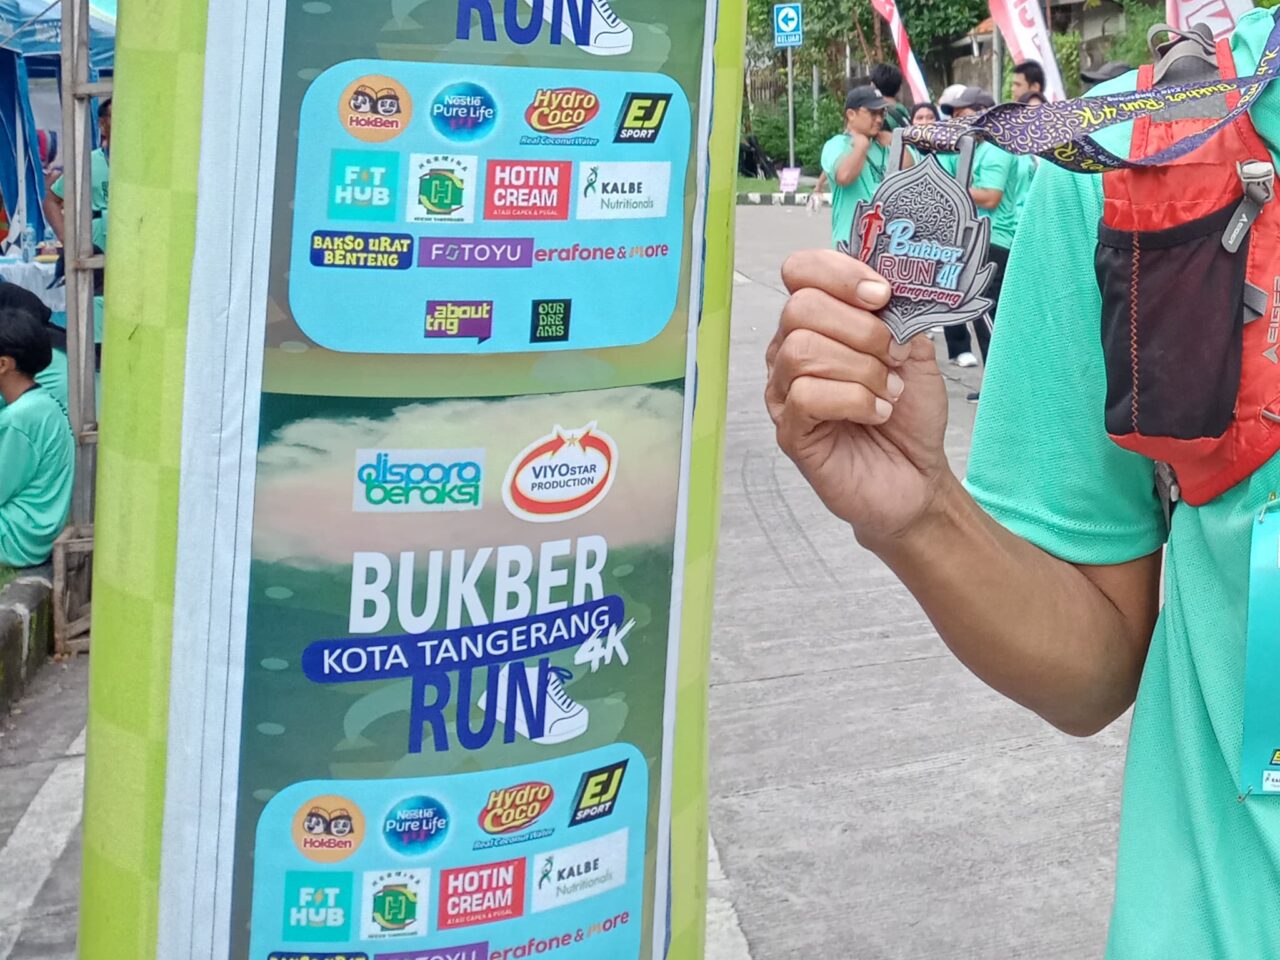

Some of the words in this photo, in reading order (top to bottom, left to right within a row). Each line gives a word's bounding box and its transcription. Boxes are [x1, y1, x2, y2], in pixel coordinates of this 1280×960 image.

[533, 89, 596, 111] Hydro
[349, 116, 398, 129] HokBen
[433, 104, 467, 118] Pure
[470, 106, 494, 123] Life
[623, 99, 667, 128] EJ
[620, 129, 655, 138] SPORT
[494, 166, 559, 186] HOTIN
[335, 185, 390, 206] HUB
[493, 189, 557, 207] CREAM
[601, 182, 643, 194] KALBE
[601, 197, 654, 211] Nutritionals
[324, 250, 399, 267] BENTENG
[534, 244, 614, 262] erafone
[617, 246, 626, 259] &
[877, 253, 937, 285] RUN
[434, 302, 491, 318] about
[538, 303, 565, 314] OUR
[425, 315, 459, 335] tng
[358, 453, 480, 486] dispora
[365, 471, 480, 506] beraksi
[530, 475, 595, 492] PRODUCTION
[348, 535, 608, 634] BUKBER
[322, 645, 408, 675] KOTA
[418, 606, 610, 667] TANGERANG
[574, 616, 636, 673] 4K
[408, 657, 550, 754] RUN
[487, 783, 551, 809] Hydro
[579, 767, 623, 809] EJ
[575, 802, 611, 820] SPORT
[386, 819, 420, 833] Pure
[422, 817, 447, 834] Life
[303, 838, 352, 849] HokBen
[448, 865, 514, 895] HOTIN
[557, 858, 600, 882] KALBE
[447, 889, 512, 915] CREAM
[290, 908, 345, 927] HUB
[490, 935, 571, 960] erafone
[574, 929, 584, 943] &
